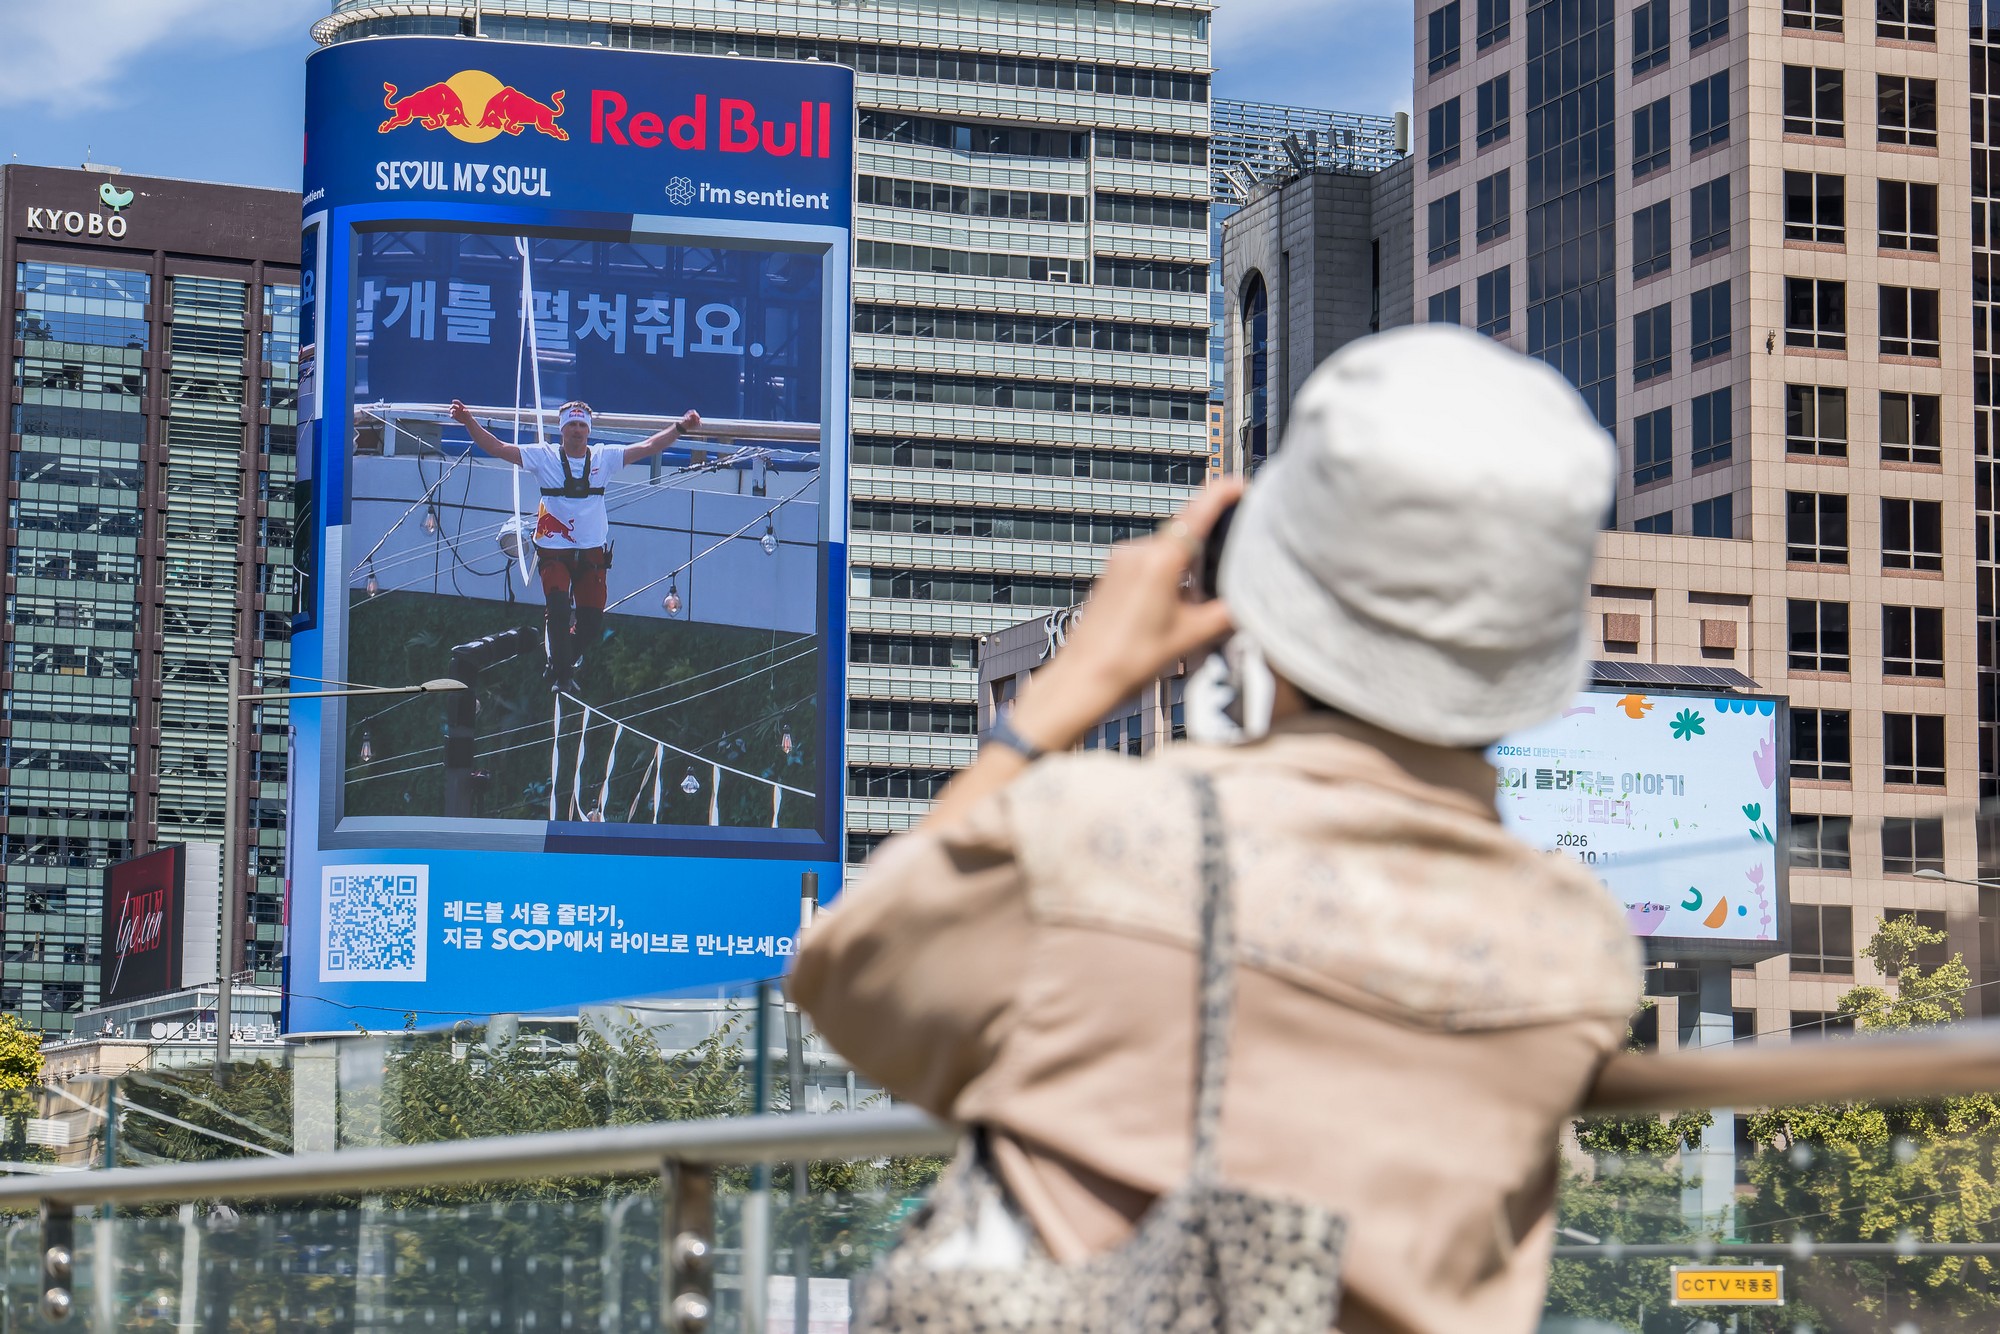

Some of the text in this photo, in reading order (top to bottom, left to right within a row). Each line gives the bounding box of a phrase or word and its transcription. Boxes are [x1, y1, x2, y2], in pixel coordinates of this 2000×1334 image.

[591, 89, 831, 158] Red Bull
[492, 165, 551, 197] SOUL
[733, 186, 830, 209] sentient
[27, 206, 128, 238] KYOBO
[516, 286, 765, 359] 펼쳐줘요.
[1497, 745, 1531, 757] 2026년
[1533, 747, 1567, 758] 대한민국
[1535, 768, 1615, 793] 들려주는
[1621, 772, 1685, 797] 이야기
[1588, 799, 1633, 825] 되다
[1556, 834, 1588, 847] 2026
[443, 900, 625, 929] 레드불 서울 줄타기,
[443, 927, 484, 949] 지금
[491, 927, 604, 954] SOOP에서
[610, 931, 689, 955] 라이브로
[1681, 1278, 1773, 1293] CCTV 작동중
